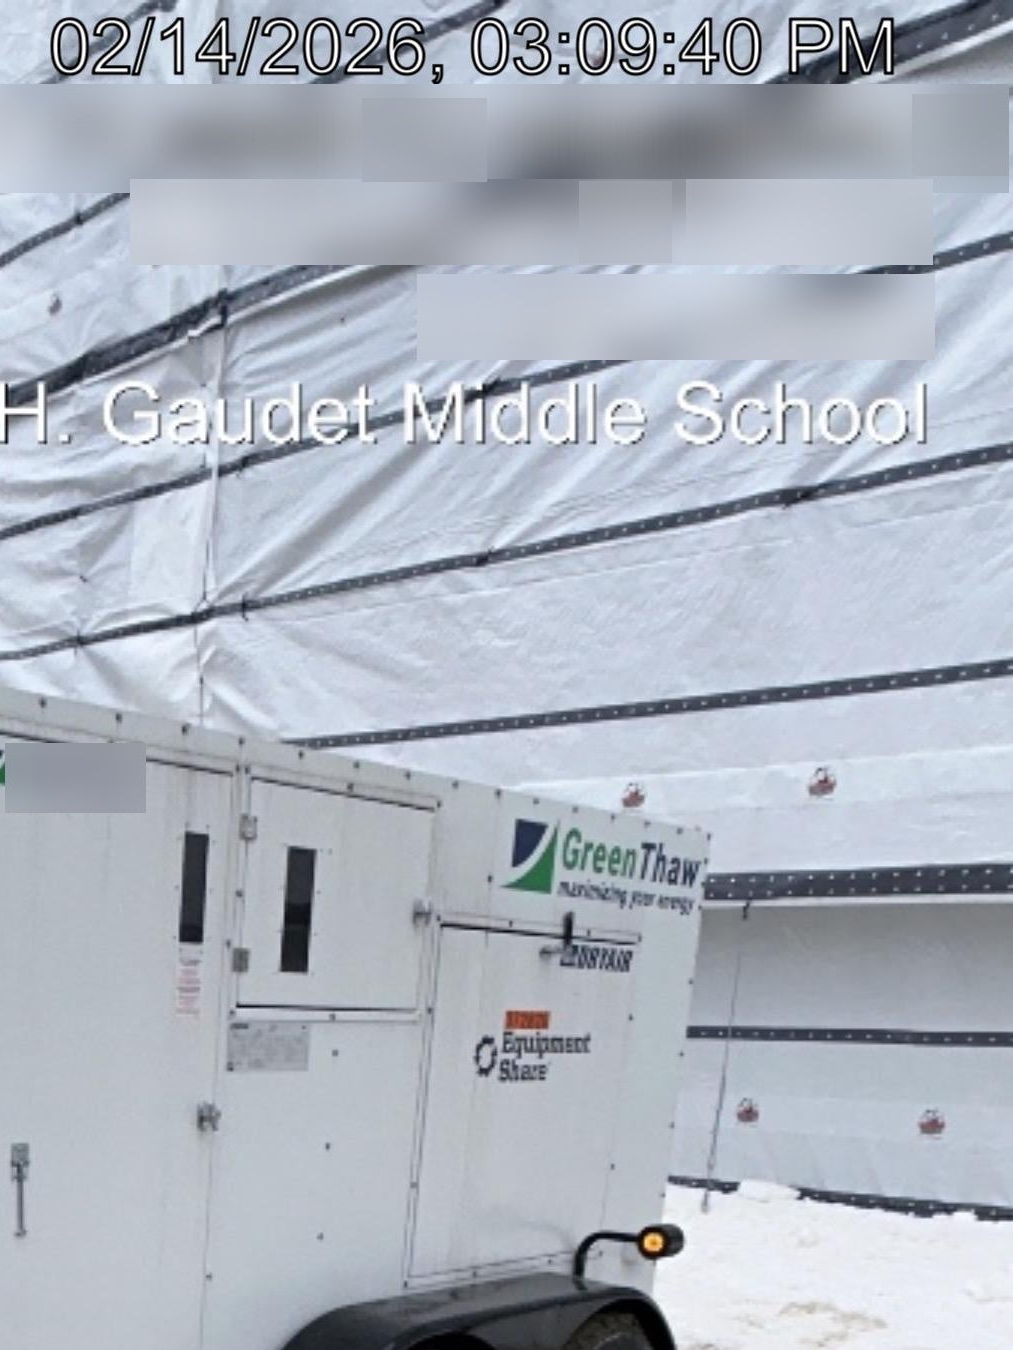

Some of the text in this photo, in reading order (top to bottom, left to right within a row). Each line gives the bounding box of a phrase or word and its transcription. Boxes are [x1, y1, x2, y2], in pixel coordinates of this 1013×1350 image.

[562, 827, 702, 889] GreenThaw
[502, 1031, 592, 1059] Equipment
[499, 1059, 549, 1082] Share
